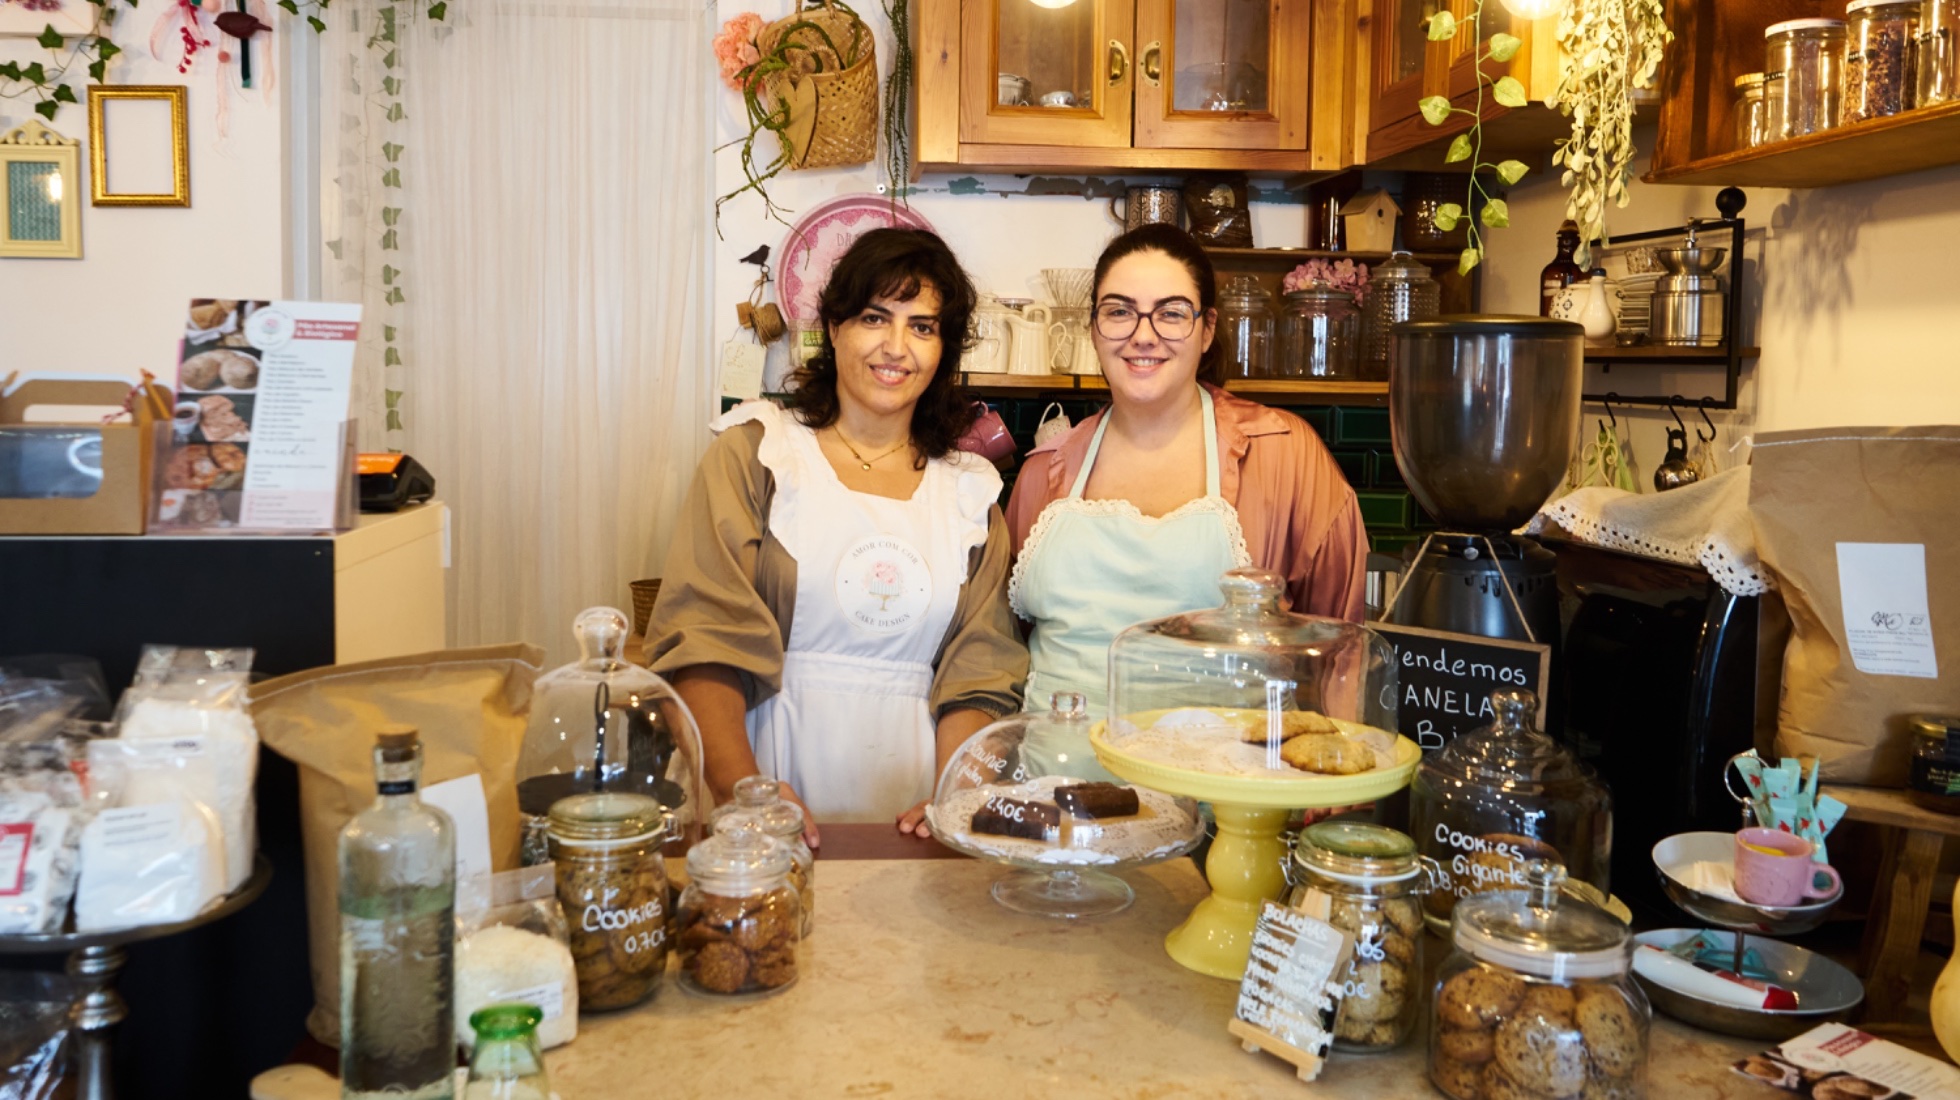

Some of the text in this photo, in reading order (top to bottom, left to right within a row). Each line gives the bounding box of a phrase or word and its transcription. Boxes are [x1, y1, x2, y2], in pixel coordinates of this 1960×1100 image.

[852, 541, 918, 565] AMOR COM COR
[855, 610, 911, 627] CAKE DESIGN
[1380, 683, 1495, 718] CANELA
[1435, 823, 1525, 864] Cookies
[1452, 854, 1532, 888] Gigante
[582, 897, 663, 932] Cookies
